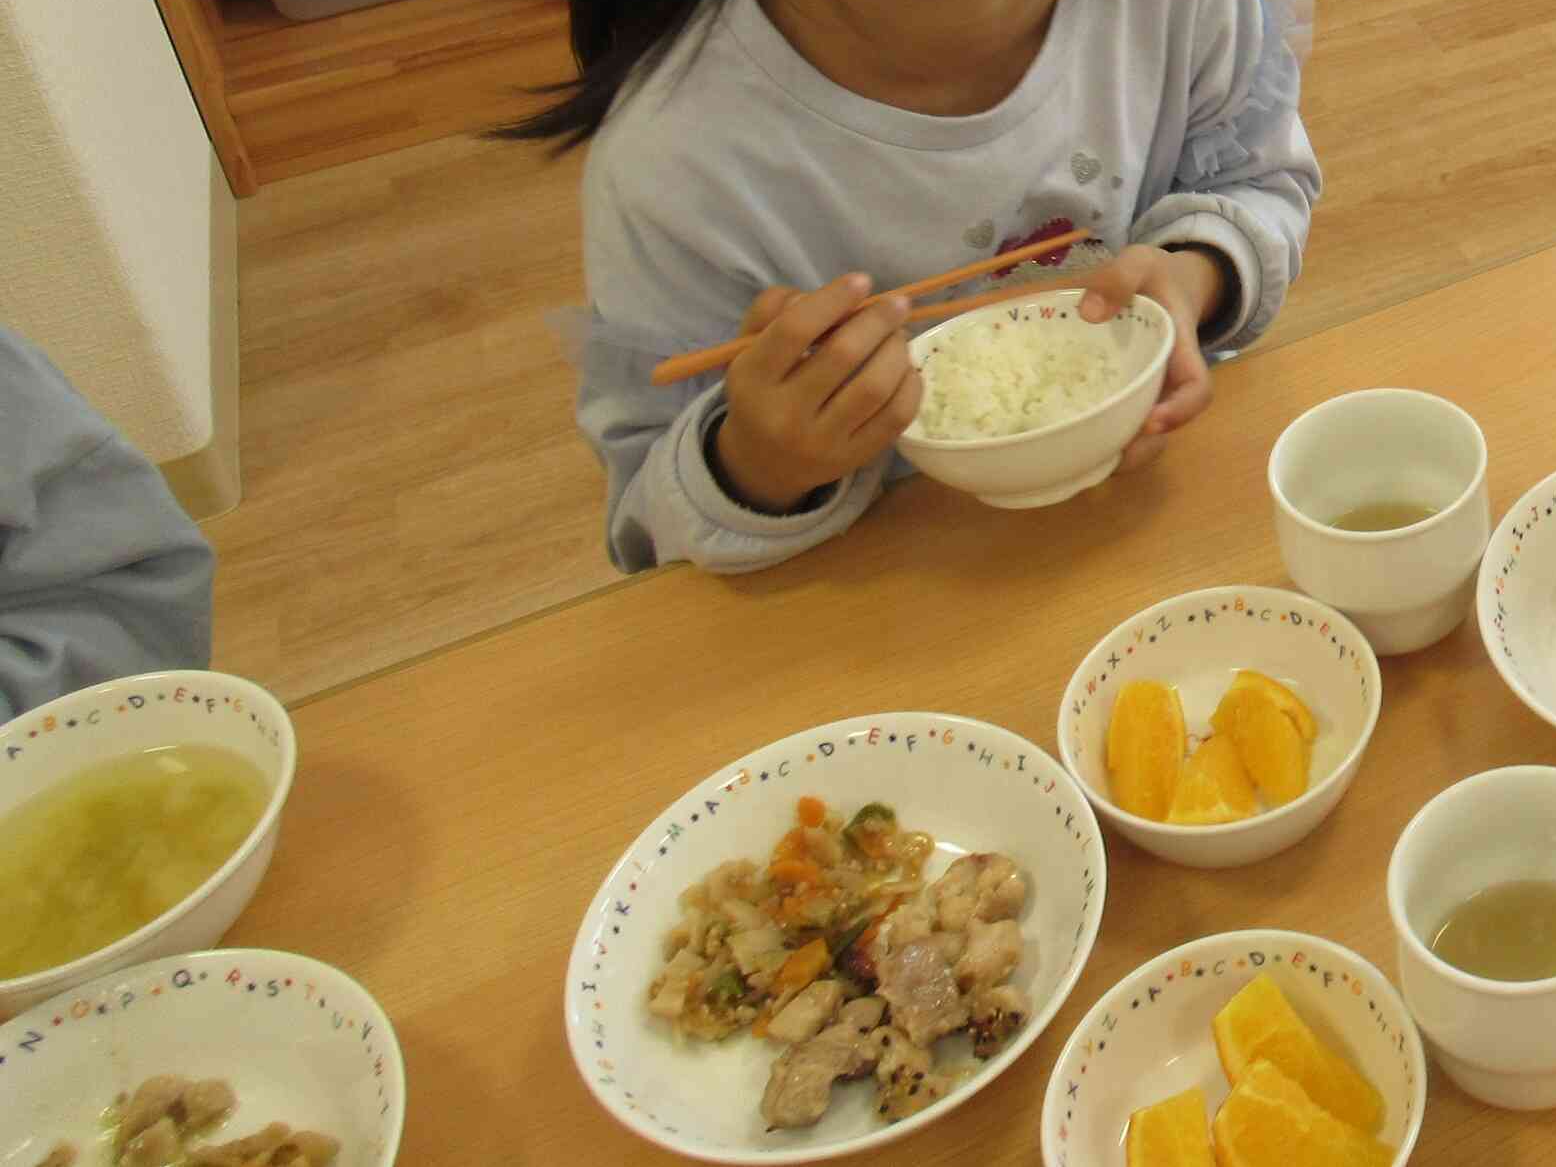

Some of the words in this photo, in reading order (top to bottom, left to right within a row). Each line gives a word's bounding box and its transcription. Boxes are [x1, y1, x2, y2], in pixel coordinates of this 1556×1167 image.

[1040, 306, 1055, 320] W
[1107, 651, 1120, 670] X
[1204, 609, 1216, 623] A
[1234, 594, 1245, 611] B
[1260, 609, 1272, 621] C
[1290, 611, 1302, 625] D
[87, 709, 101, 725] C
[127, 695, 144, 709] D
[173, 687, 187, 703] E
[206, 698, 217, 714] F
[705, 800, 720, 815] A
[778, 760, 790, 777] C
[819, 742, 834, 756] D
[867, 727, 880, 745] E
[906, 734, 917, 752] F
[978, 748, 993, 766] H
[1017, 755, 1026, 771] I
[18, 1031, 44, 1053] N
[71, 1000, 90, 1019] O
[172, 969, 195, 988] Q
[225, 968, 241, 986] R
[267, 980, 279, 997] S
[1067, 1080, 1078, 1100] X
[1149, 986, 1161, 1002] A
[1214, 960, 1225, 975] C
[1249, 951, 1265, 966] D
[1324, 972, 1333, 987] F
